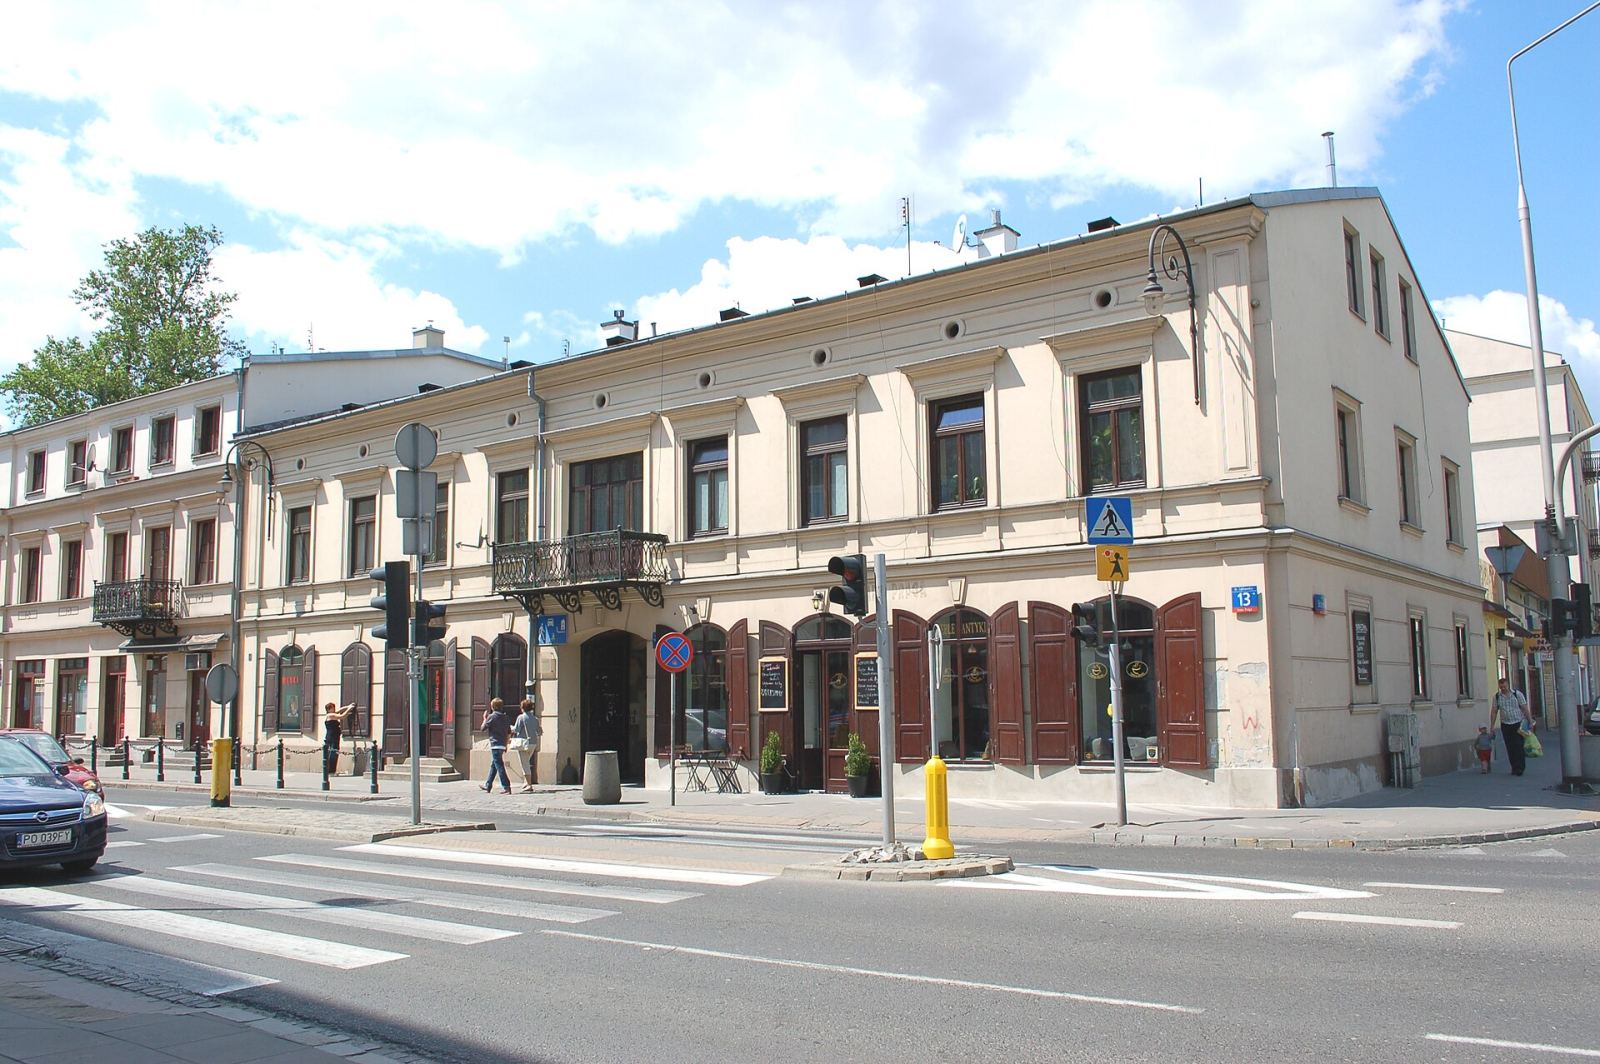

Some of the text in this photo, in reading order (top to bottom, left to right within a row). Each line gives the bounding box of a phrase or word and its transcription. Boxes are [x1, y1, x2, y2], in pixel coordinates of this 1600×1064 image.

[1237, 592, 1251, 607] 13
[962, 621, 986, 635] ANTYKI
[23, 834, 38, 845] PO
